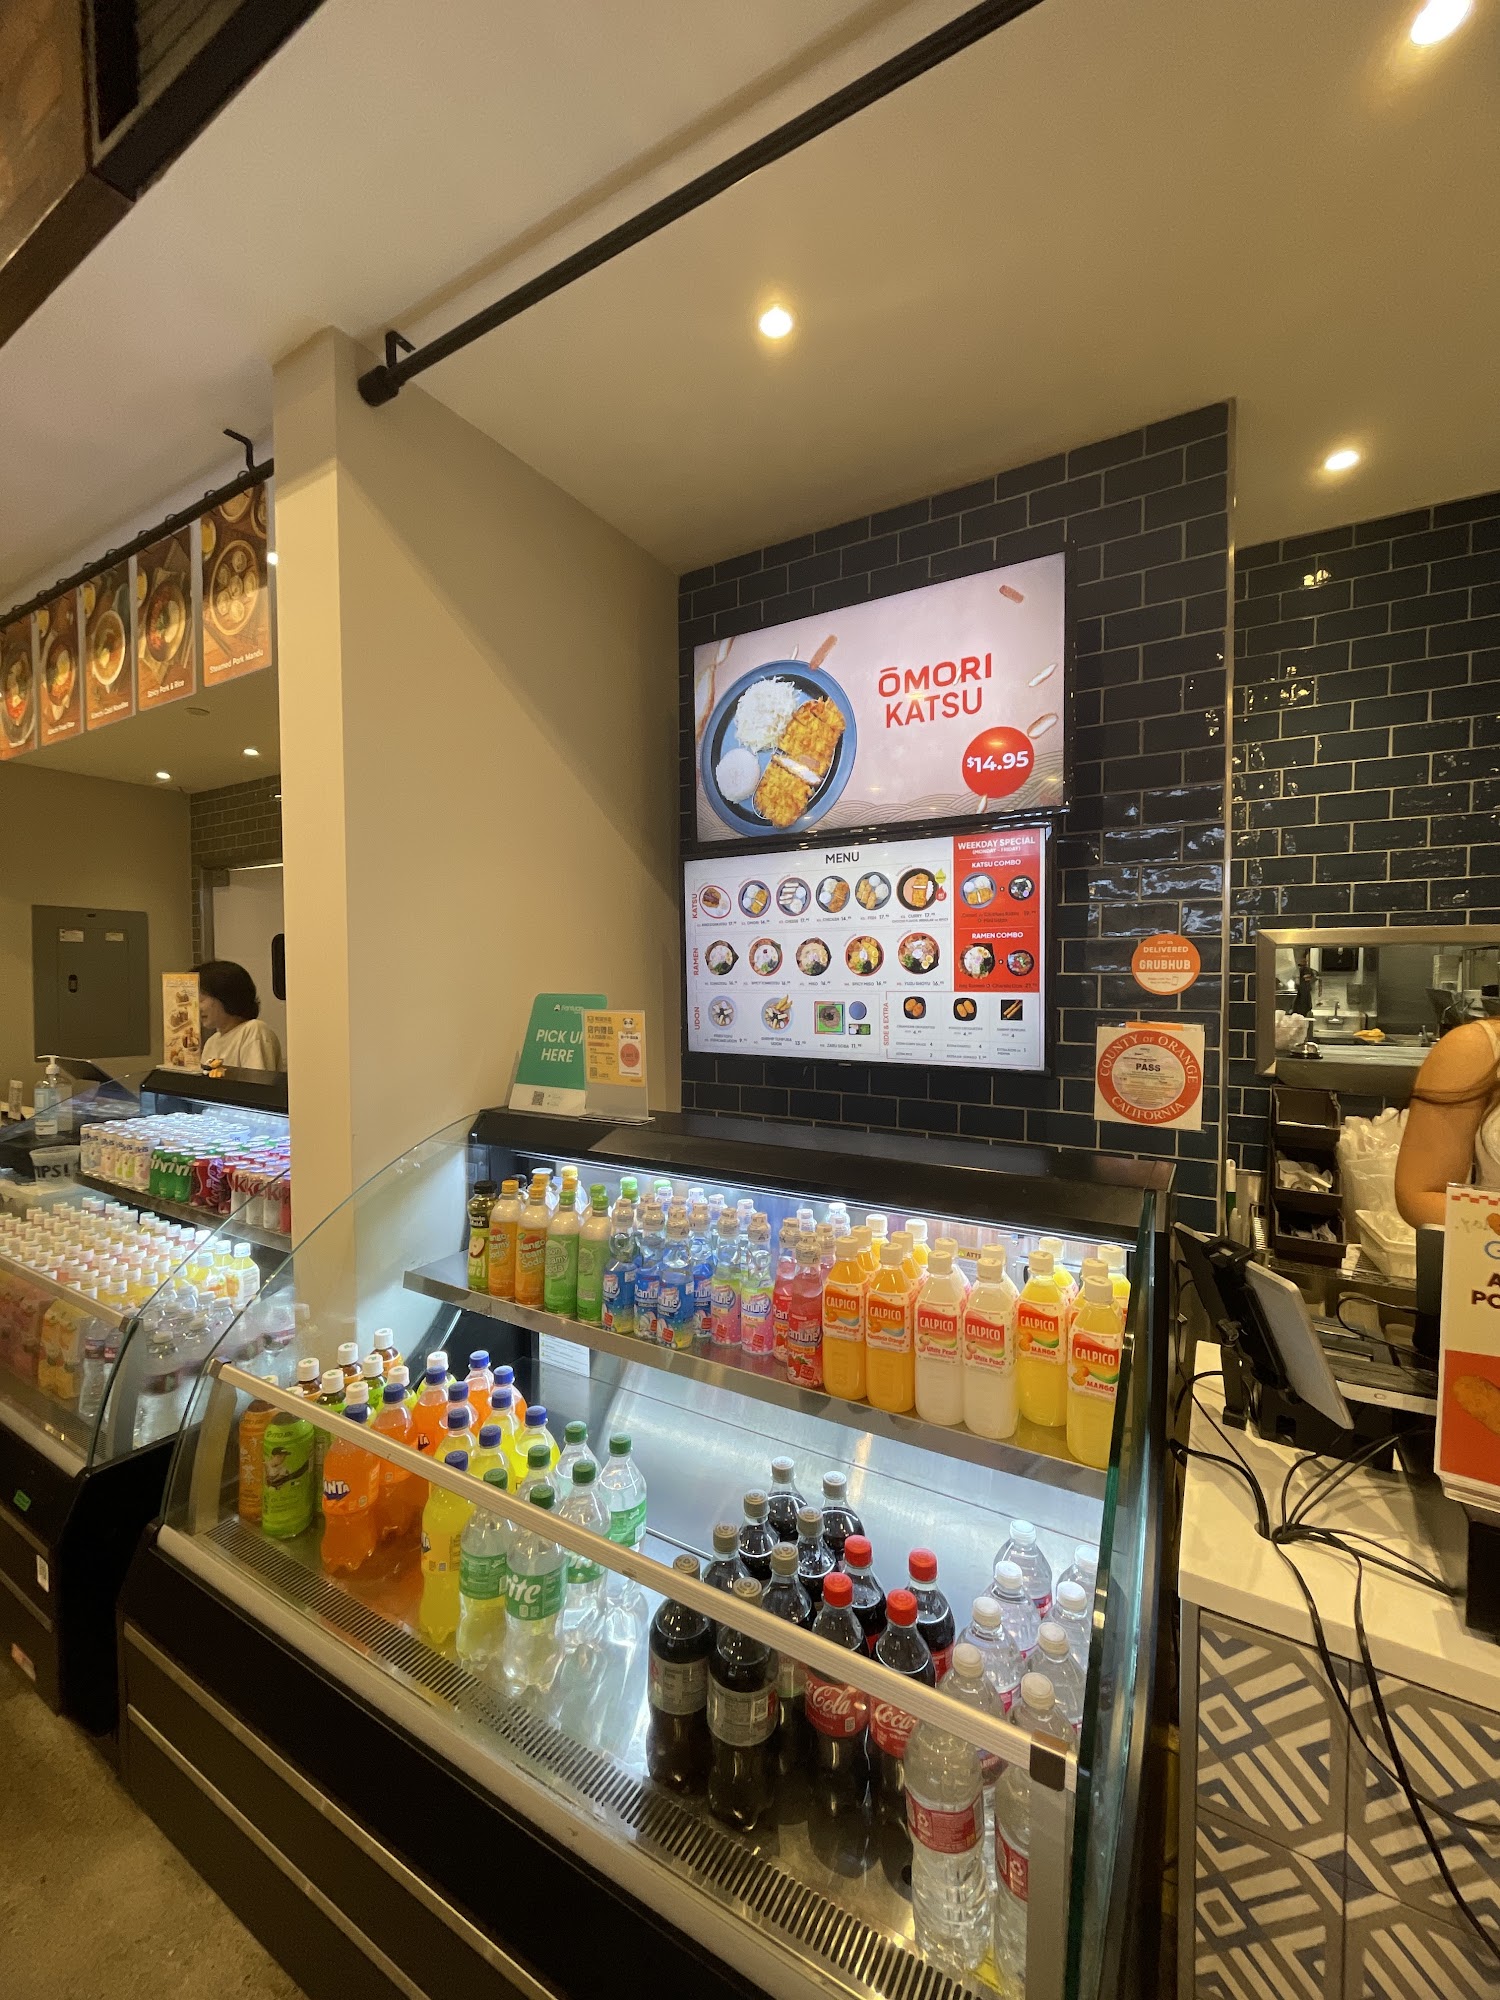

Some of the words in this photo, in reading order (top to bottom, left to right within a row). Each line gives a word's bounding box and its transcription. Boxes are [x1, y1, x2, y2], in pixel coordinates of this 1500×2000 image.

[209, 660, 232, 673] Steamed
[232, 655, 245, 665] Pork
[885, 686, 983, 729] KATSU
[966, 750, 1029, 773] $14.95
[958, 840, 998, 850] WEEKDAY
[999, 837, 1036, 847] SPECIAL
[825, 851, 860, 865] MENU
[994, 859, 1021, 867] COMBO
[1139, 960, 1191, 970] GRUBHUB
[536, 1028, 566, 1044] PICK
[541, 1048, 574, 1063] HERE
[1100, 1034, 1139, 1077] COUNTY
[1158, 1035, 1199, 1084] ORANGE
[1136, 1063, 1161, 1072] PASS
[1112, 1096, 1185, 1120] CALIFORNIA
[489, 1233, 507, 1242] ango
[489, 1241, 510, 1250] eamy
[489, 1250, 506, 1259] oda
[518, 1248, 545, 1260] Cream
[521, 1257, 545, 1268] Soda
[634, 1285, 658, 1298] Ramun
[742, 1302, 767, 1313] amune
[826, 1296, 856, 1311] CALPICO
[870, 1306, 901, 1321] CALPICO
[920, 1317, 953, 1332] CALPICO
[1020, 1315, 1054, 1332] CALPICO
[966, 1324, 1000, 1341] CALPICO
[1031, 1346, 1056, 1356] MANGO
[1075, 1347, 1115, 1366] CALPICO
[1087, 1381, 1115, 1392] MANGO
[506, 1574, 541, 1604] rite
